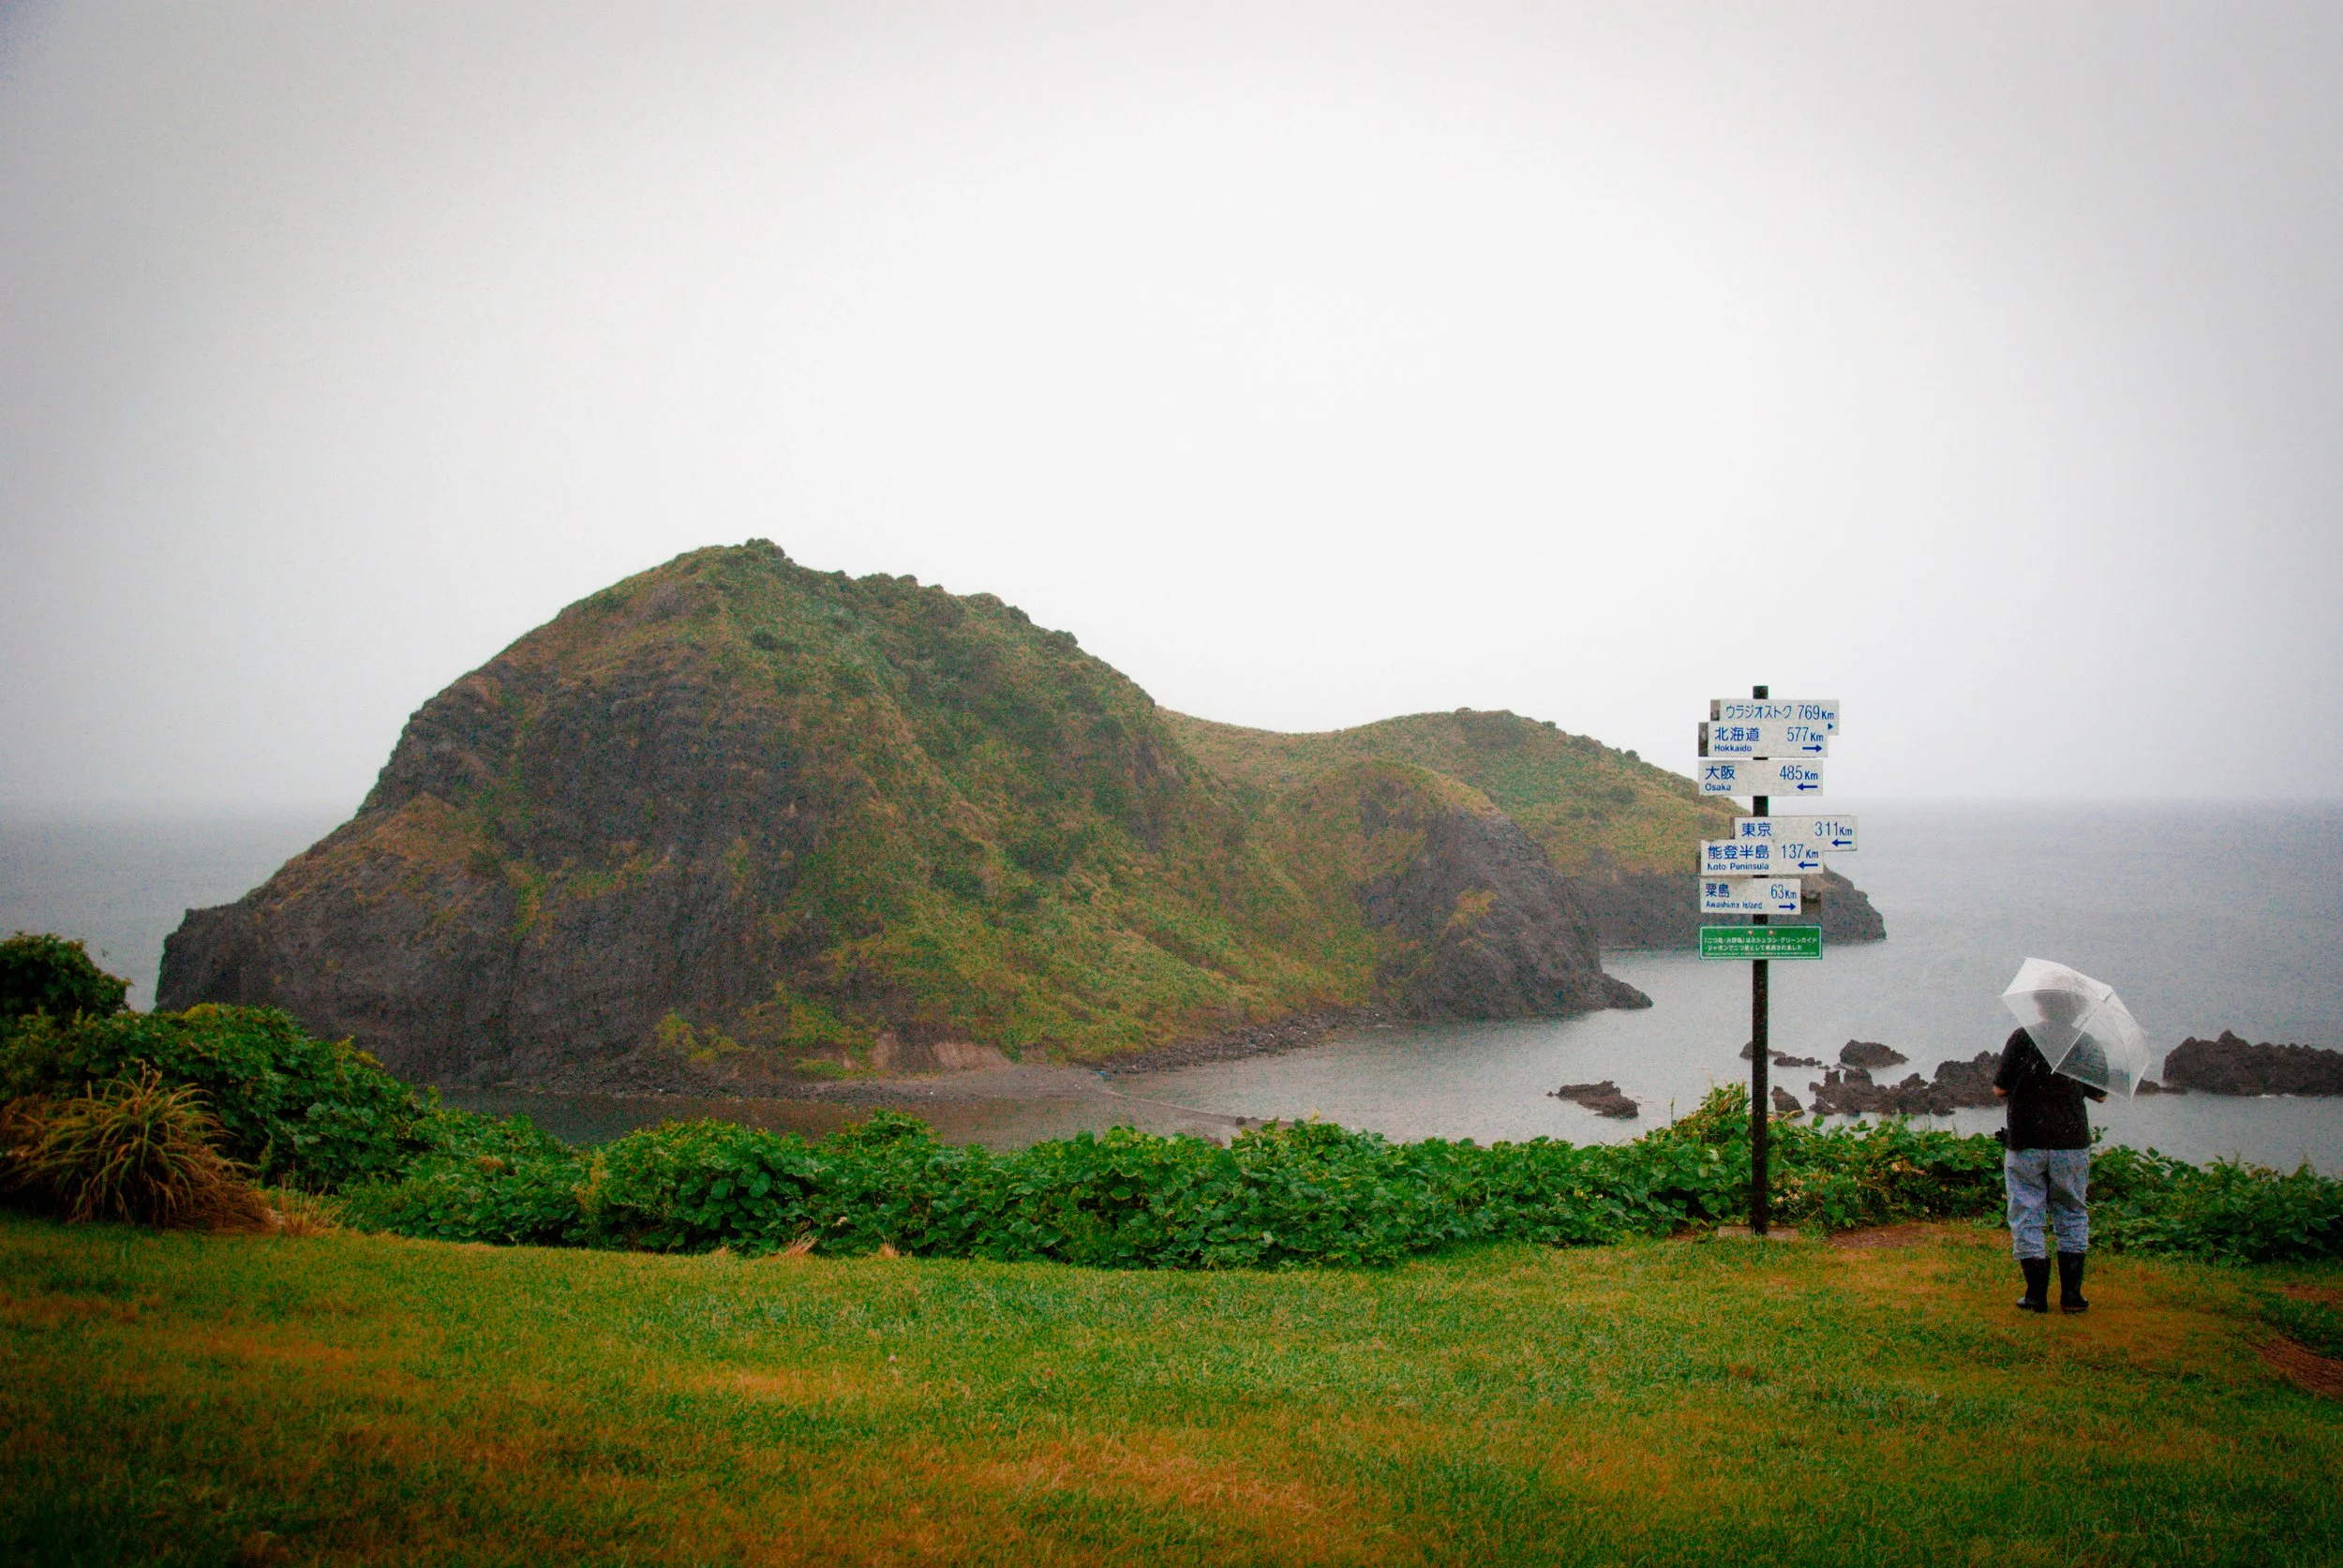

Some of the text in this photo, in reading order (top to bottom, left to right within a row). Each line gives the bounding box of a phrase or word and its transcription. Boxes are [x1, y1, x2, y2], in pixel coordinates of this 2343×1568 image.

[1725, 705, 1792, 719] ウラジオストク
[1714, 726, 1760, 741] 北海道
[1714, 744, 1753, 753] Hokkaido
[1705, 765, 1736, 780] 大阪
[1705, 783, 1732, 792] Osaka
[1741, 822, 1772, 837] 東京
[1708, 844, 1769, 859] 能登半島
[1730, 861, 1769, 871] Peninsula
[1706, 883, 1730, 898] 粟島
[1743, 901, 1762, 909] Island
